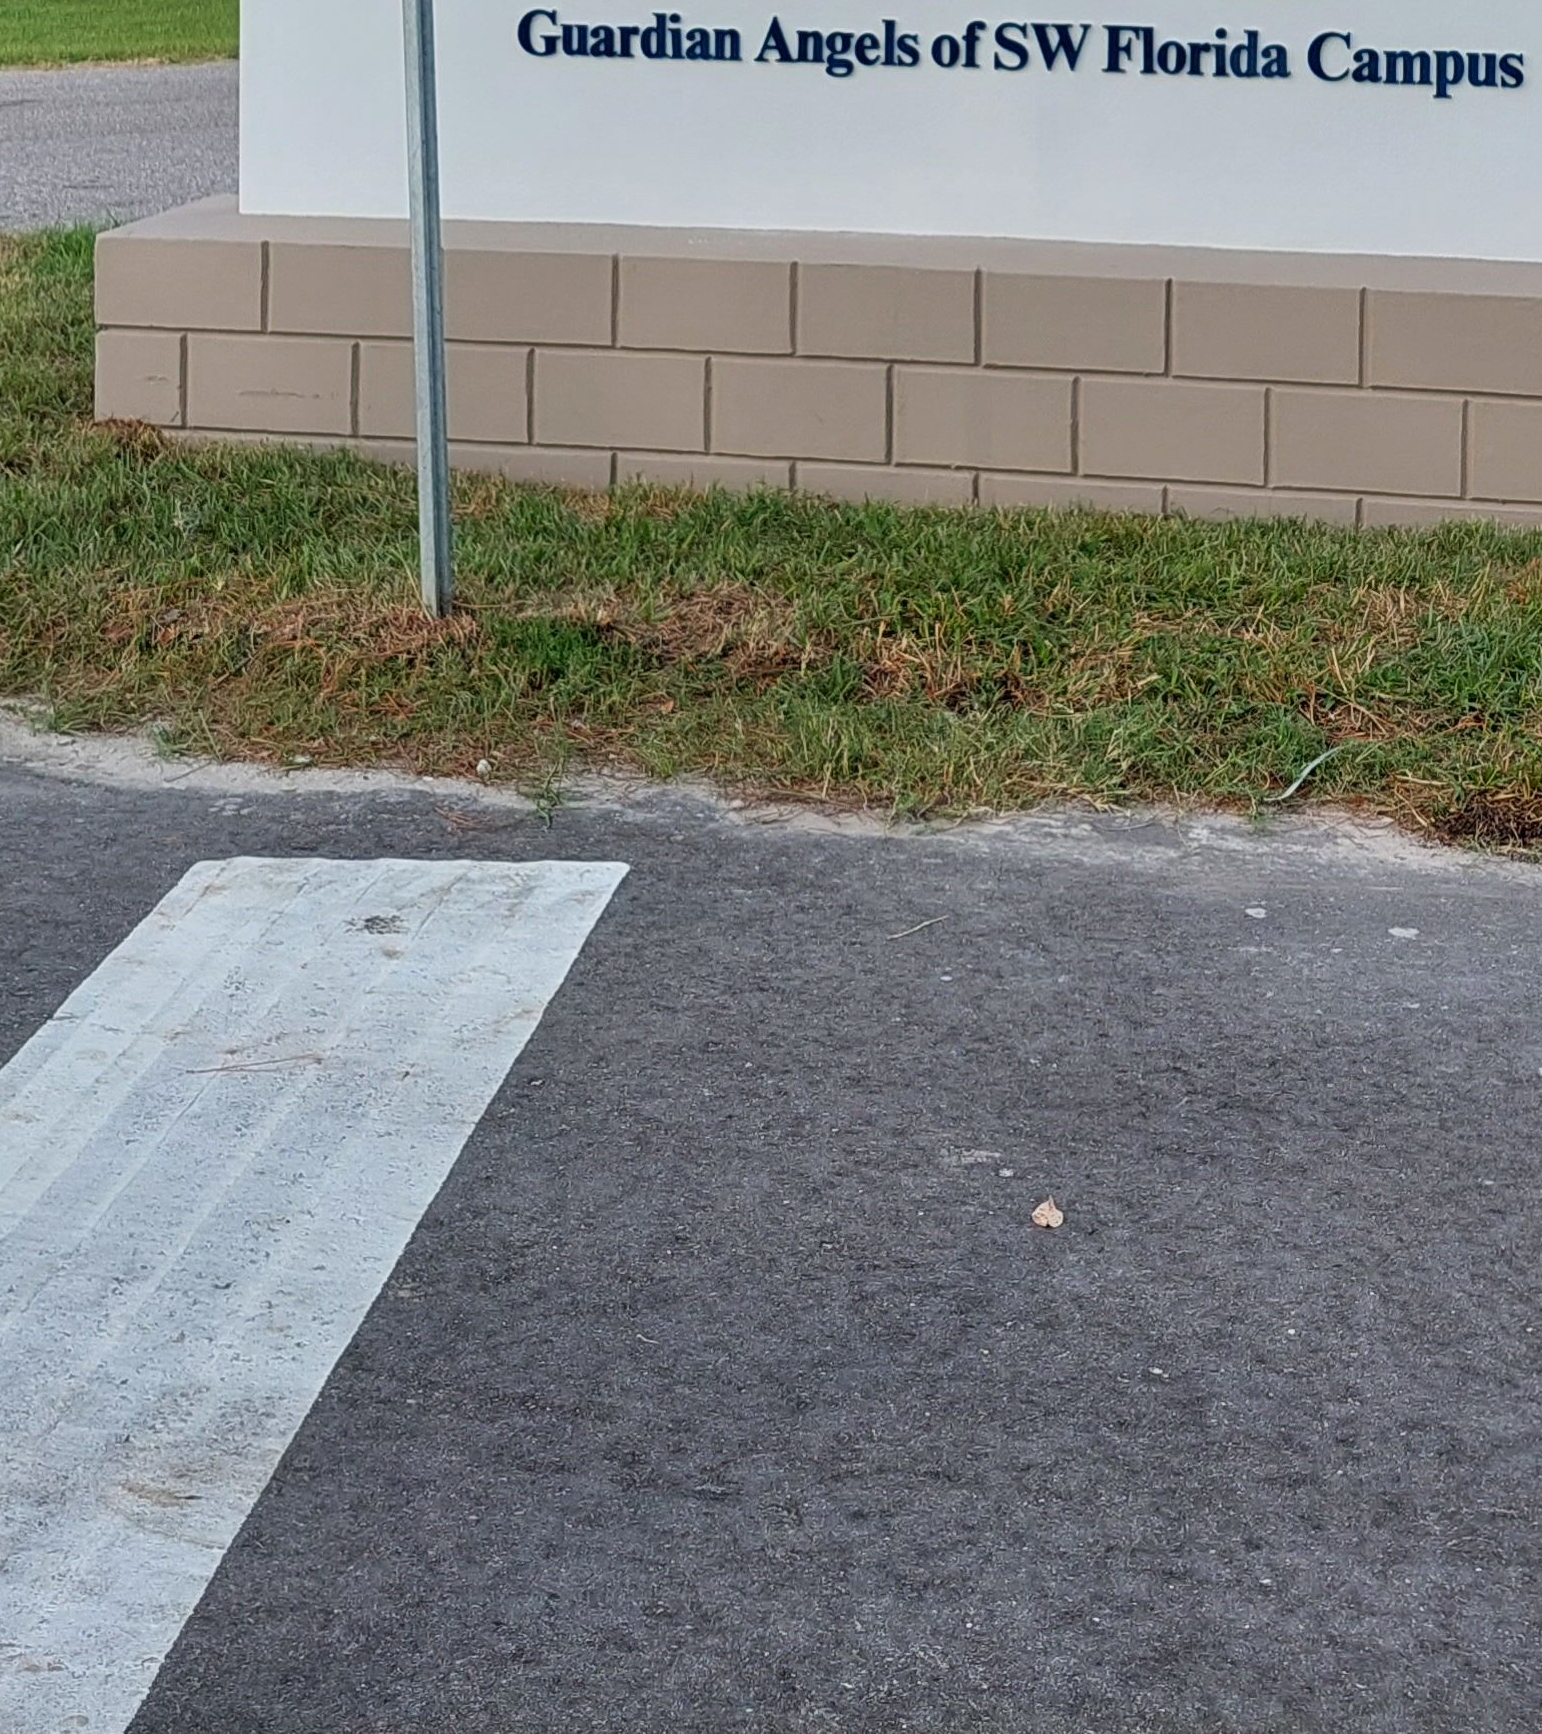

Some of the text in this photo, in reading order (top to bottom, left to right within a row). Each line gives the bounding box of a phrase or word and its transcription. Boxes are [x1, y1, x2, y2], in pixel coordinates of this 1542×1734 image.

[517, 8, 1525, 100] Guardian Angels of SW Florida Campus
